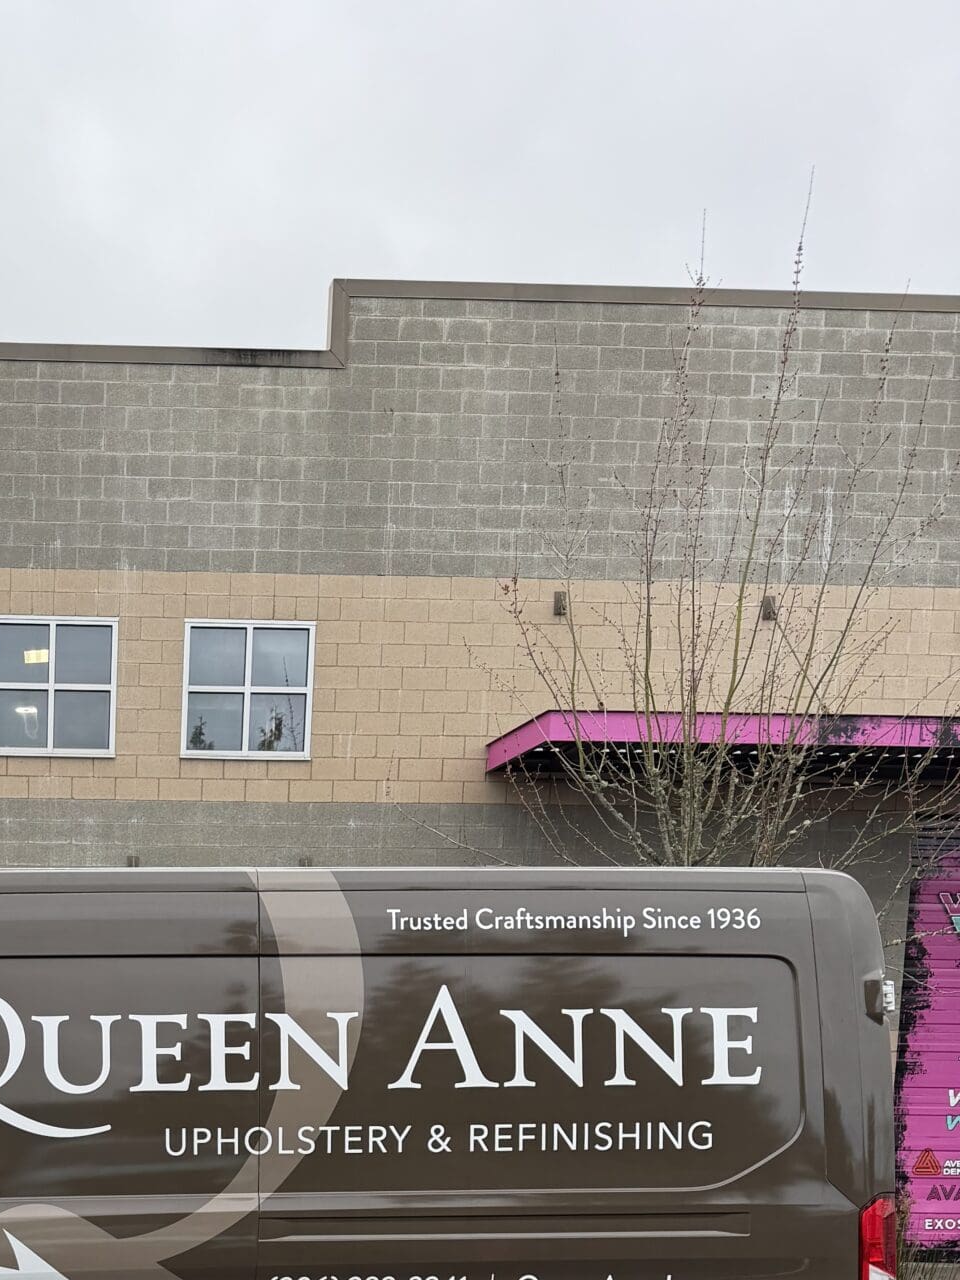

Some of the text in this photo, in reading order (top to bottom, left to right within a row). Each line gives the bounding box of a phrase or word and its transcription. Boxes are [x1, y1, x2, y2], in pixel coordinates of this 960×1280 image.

[386, 907, 762, 938] Trusted Craftsmanship Since 1936
[386, 984, 763, 1089] ANNE
[165, 1121, 714, 1156] UPHOLSTERY & REFINISHING
